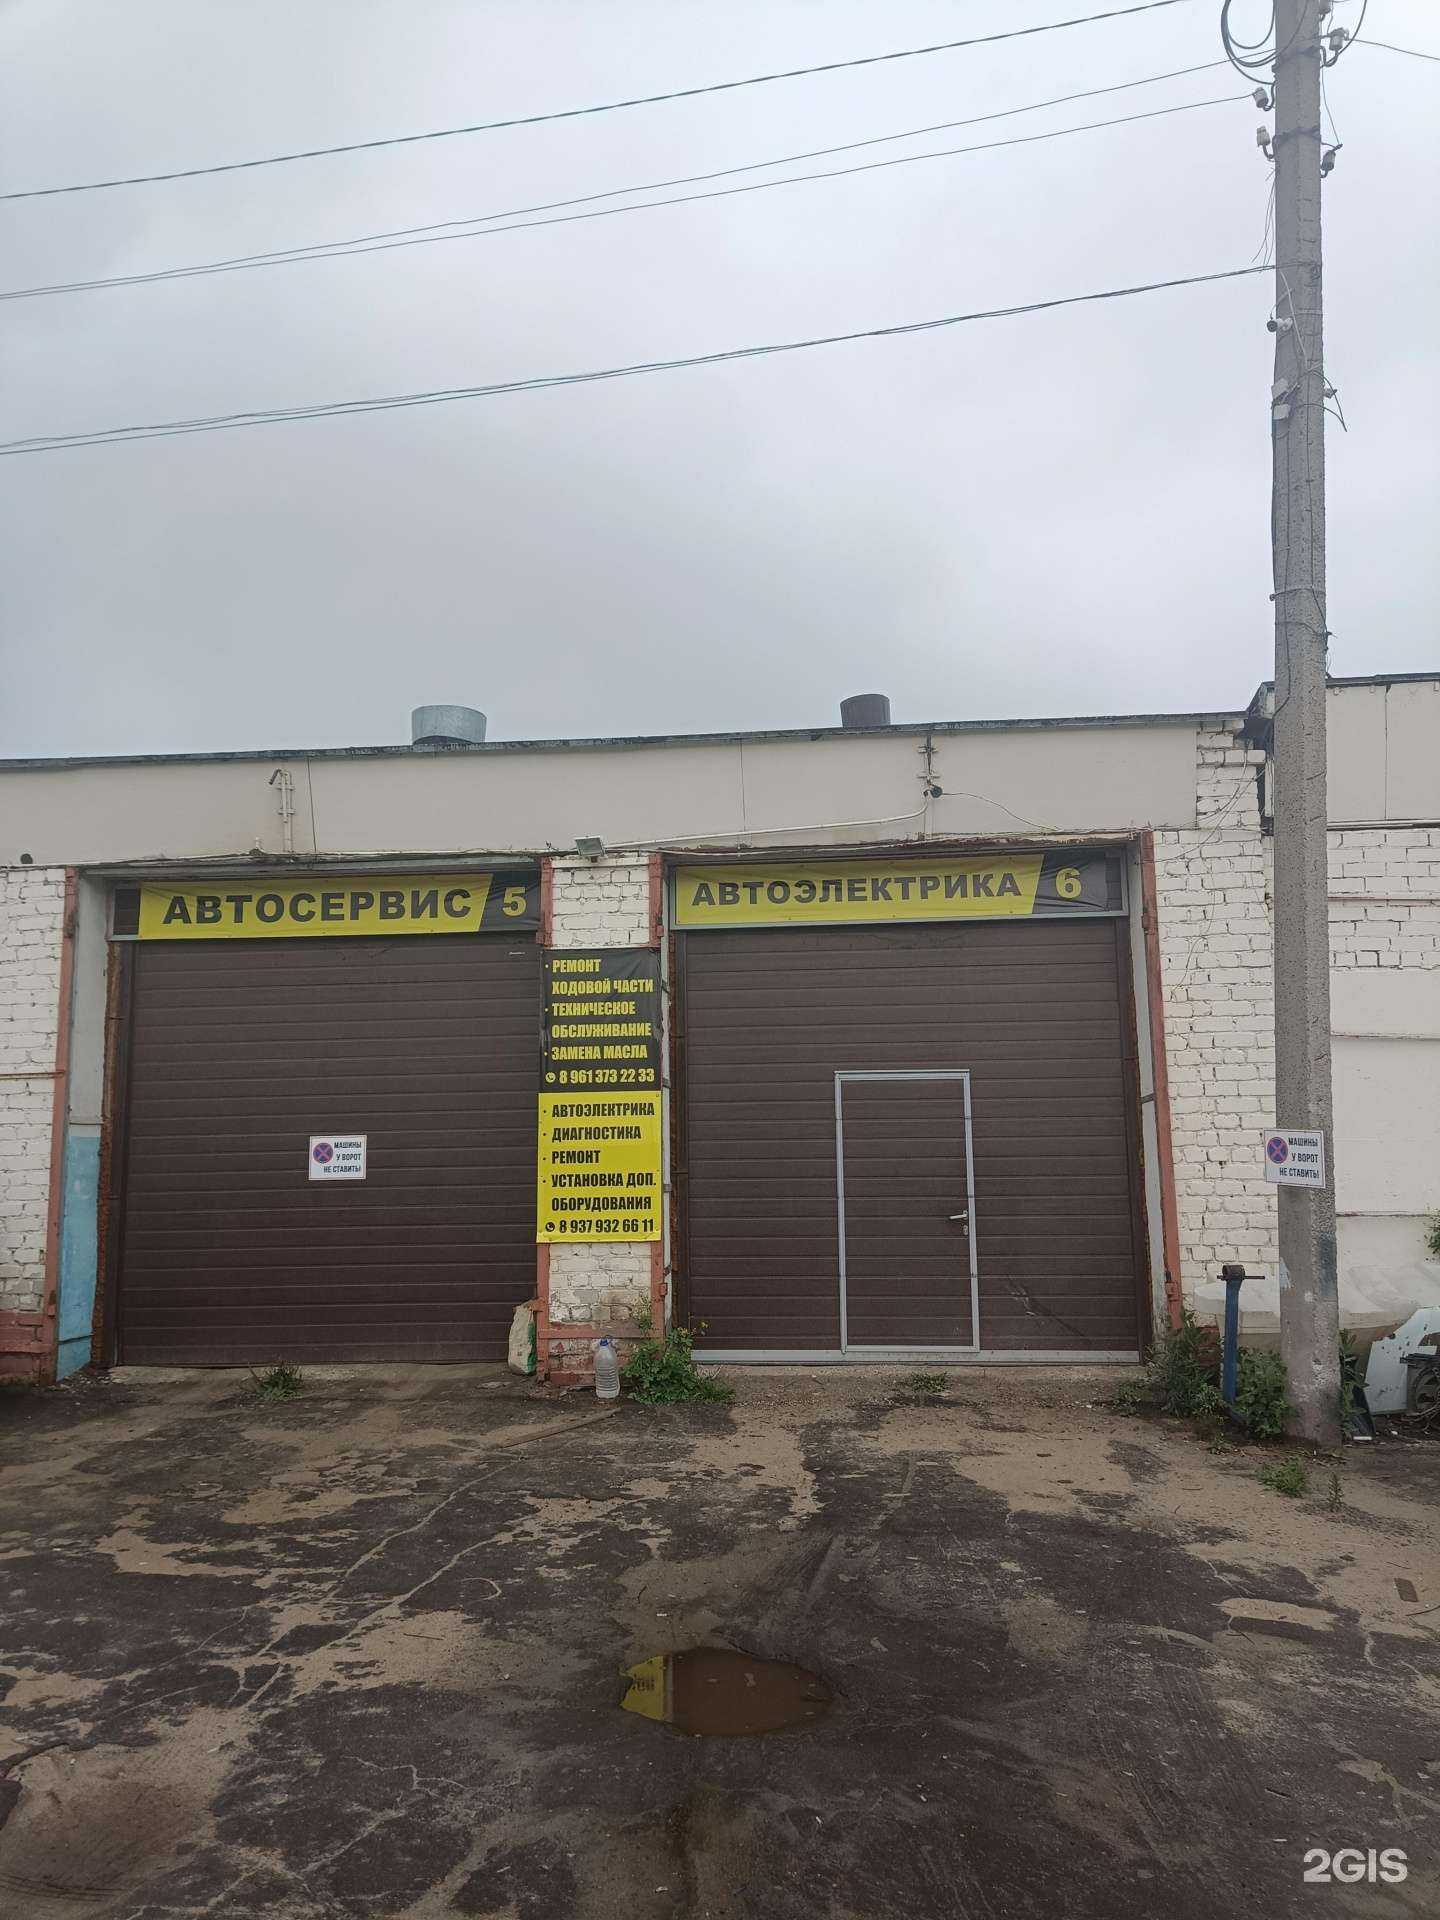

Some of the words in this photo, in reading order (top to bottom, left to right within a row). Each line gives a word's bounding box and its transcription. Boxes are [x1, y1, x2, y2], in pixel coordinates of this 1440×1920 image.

[691, 872, 1022, 906] АВТОЭЛЕКТРИКА
[1055, 867, 1081, 899] 6
[162, 889, 472, 925] АВТОСЕРВИС
[502, 886, 527, 917] 5
[552, 958, 601, 973] РЕМОНТ
[552, 977, 611, 996] ХОДОВОЙ
[613, 979, 654, 993] ЧАСТИ
[552, 1001, 636, 1017] ТЕХНИЧЕСКОЕ
[551, 1023, 652, 1038] ОБСЛУЖИВАНИЕ
[551, 1046, 602, 1061] ЗАМЕНА
[603, 1044, 648, 1059] МАСЛА
[559, 1070, 568, 1084] 8
[570, 1069, 594, 1084] 961
[595, 1069, 618, 1083] 373
[619, 1069, 636, 1083] 22
[638, 1068, 655, 1083] 33
[552, 1102, 655, 1117] АВТОЭЛЕКТРИКА
[552, 1126, 642, 1143] ДИАГНОСТИКА
[1288, 1137, 1318, 1147] МАШИНЫ
[552, 1150, 601, 1165] РЕМОНТ
[1292, 1153, 1296, 1162] У
[1298, 1153, 1318, 1163] ВОРОТ
[551, 1173, 624, 1188] УСТАНОВКА
[626, 1172, 657, 1188] ДОП.
[1280, 1168, 1288, 1176] НЕ
[551, 1196, 652, 1212] ОБОРУДОВАНИЯ
[559, 1220, 568, 1233] 8
[570, 1220, 593, 1233] 937
[595, 1219, 620, 1233] 932
[622, 1219, 640, 1233] 66
[642, 1219, 654, 1232] 11
